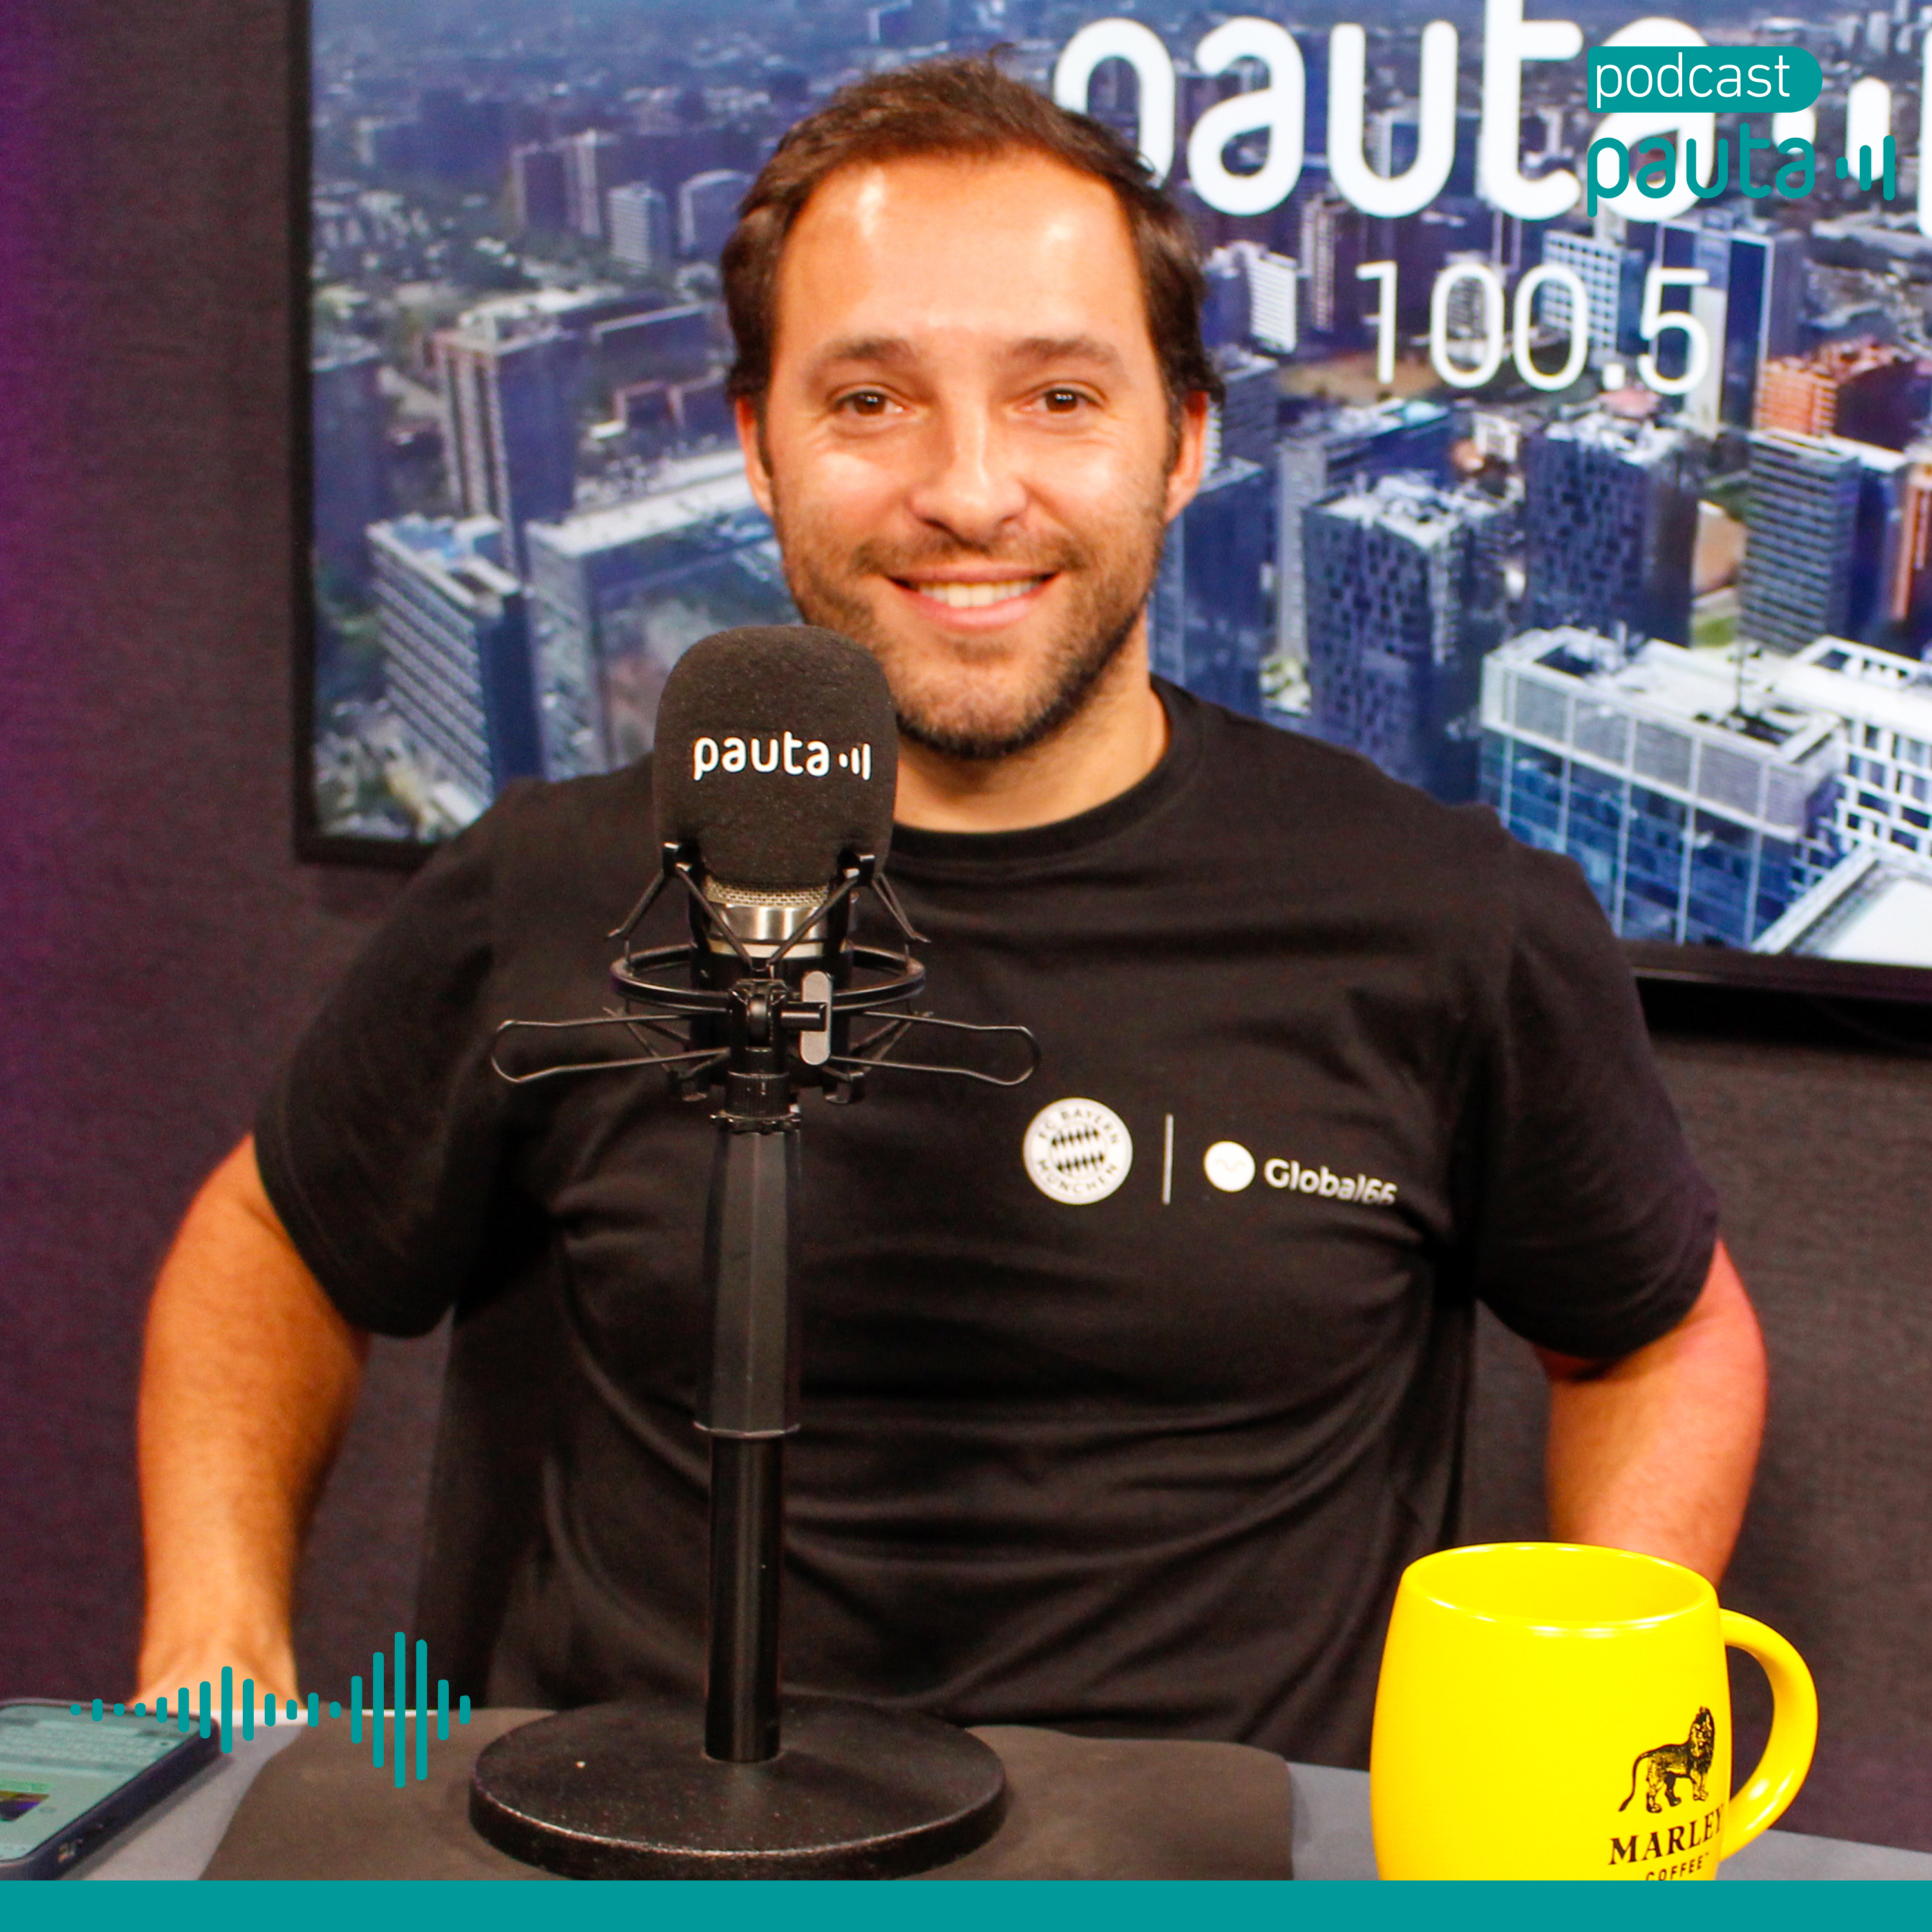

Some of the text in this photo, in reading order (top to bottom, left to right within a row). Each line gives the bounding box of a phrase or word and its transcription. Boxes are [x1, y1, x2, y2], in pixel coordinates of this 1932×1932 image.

[1356, 260, 1710, 395] 100.5
[693, 730, 831, 781] pauta
[1264, 1158, 1398, 1205] Global66
